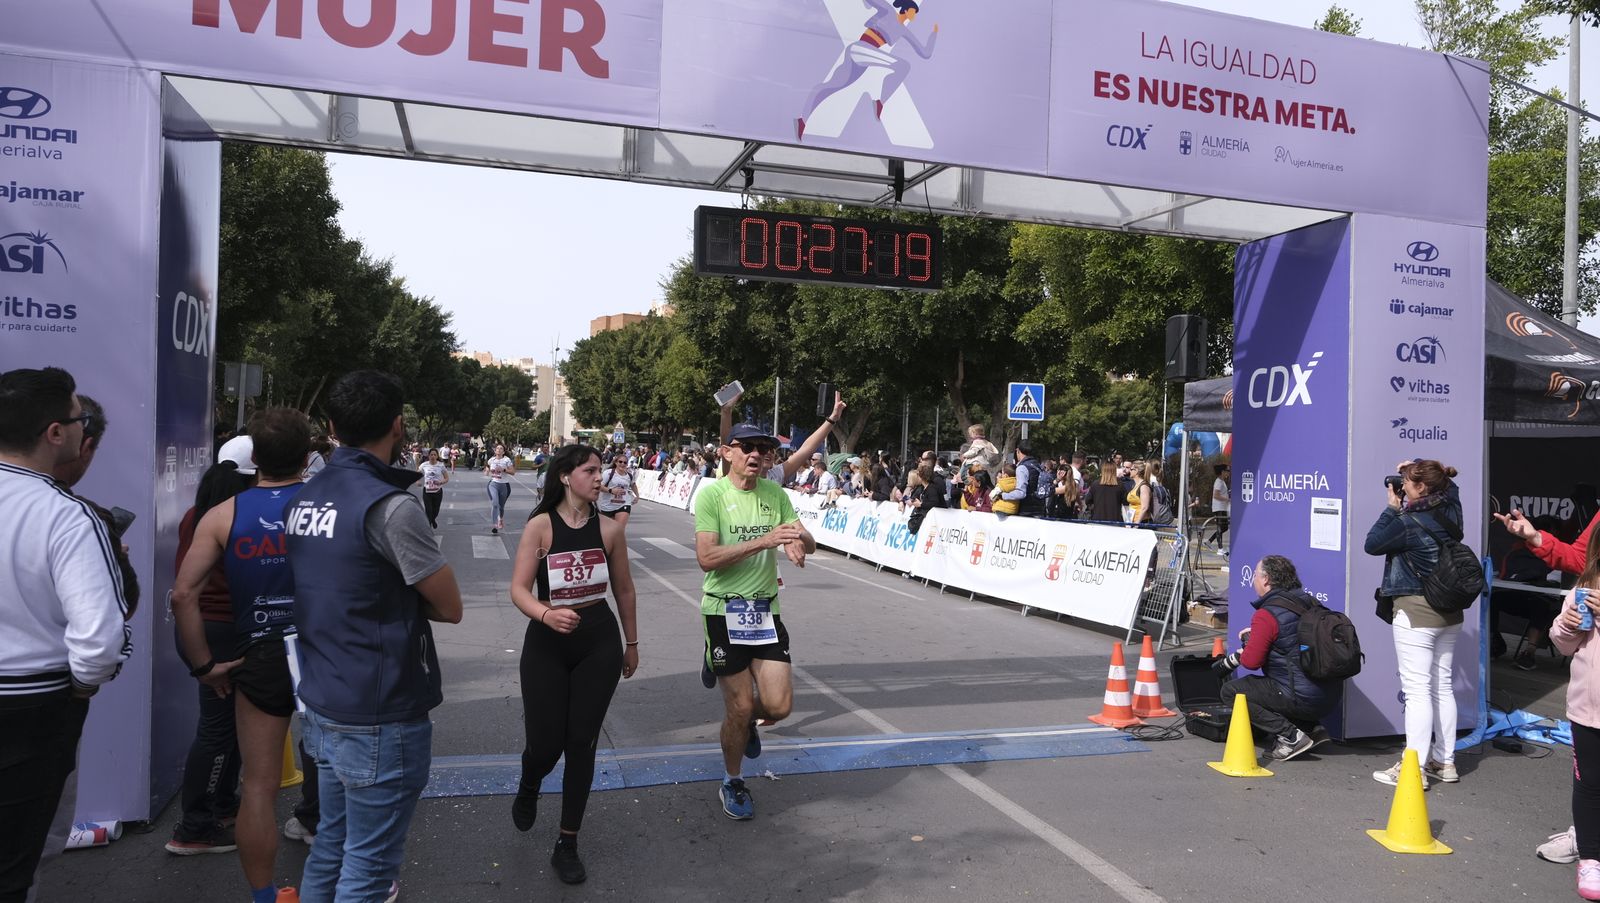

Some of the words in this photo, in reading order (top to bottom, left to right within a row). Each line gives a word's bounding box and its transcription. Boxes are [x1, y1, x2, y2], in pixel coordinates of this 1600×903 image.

[1141, 31, 1174, 62] LA
[1183, 38, 1317, 85] IGUALDAD
[1094, 70, 1130, 101] ES
[1138, 76, 1269, 123] NUESTRA
[1275, 99, 1356, 135] META.
[1106, 125, 1151, 150] CDX
[1202, 136, 1250, 152] ALMERÍA
[0, 144, 62, 160] erialva
[1201, 149, 1227, 159] CIUDAD
[740, 217, 931, 282] 00:27:19
[1394, 262, 1451, 278] HYUNDAI
[1401, 276, 1445, 289] Almerialva
[0, 296, 77, 319] ithas
[1408, 302, 1454, 317] cajamar
[34, 323, 77, 333] cuidarte
[173, 291, 210, 357] CDX
[1396, 343, 1436, 364] CASI
[1248, 356, 1322, 409] CDX
[1408, 379, 1450, 395] vithas
[1399, 426, 1448, 443] aqualia
[1264, 471, 1330, 491] ALMERÍA
[1264, 490, 1295, 502] CIUDAD
[1510, 494, 1575, 521] cruza
[938, 527, 968, 547] ALMERÍA
[993, 536, 1046, 561] ALMERÍA
[990, 556, 1018, 571] CIUDAD
[1074, 549, 1141, 575] ALMERÍA
[563, 564, 594, 582] 837
[1072, 569, 1105, 586] CIUDAD
[738, 612, 762, 625] 338
[207, 753, 224, 793] joma
